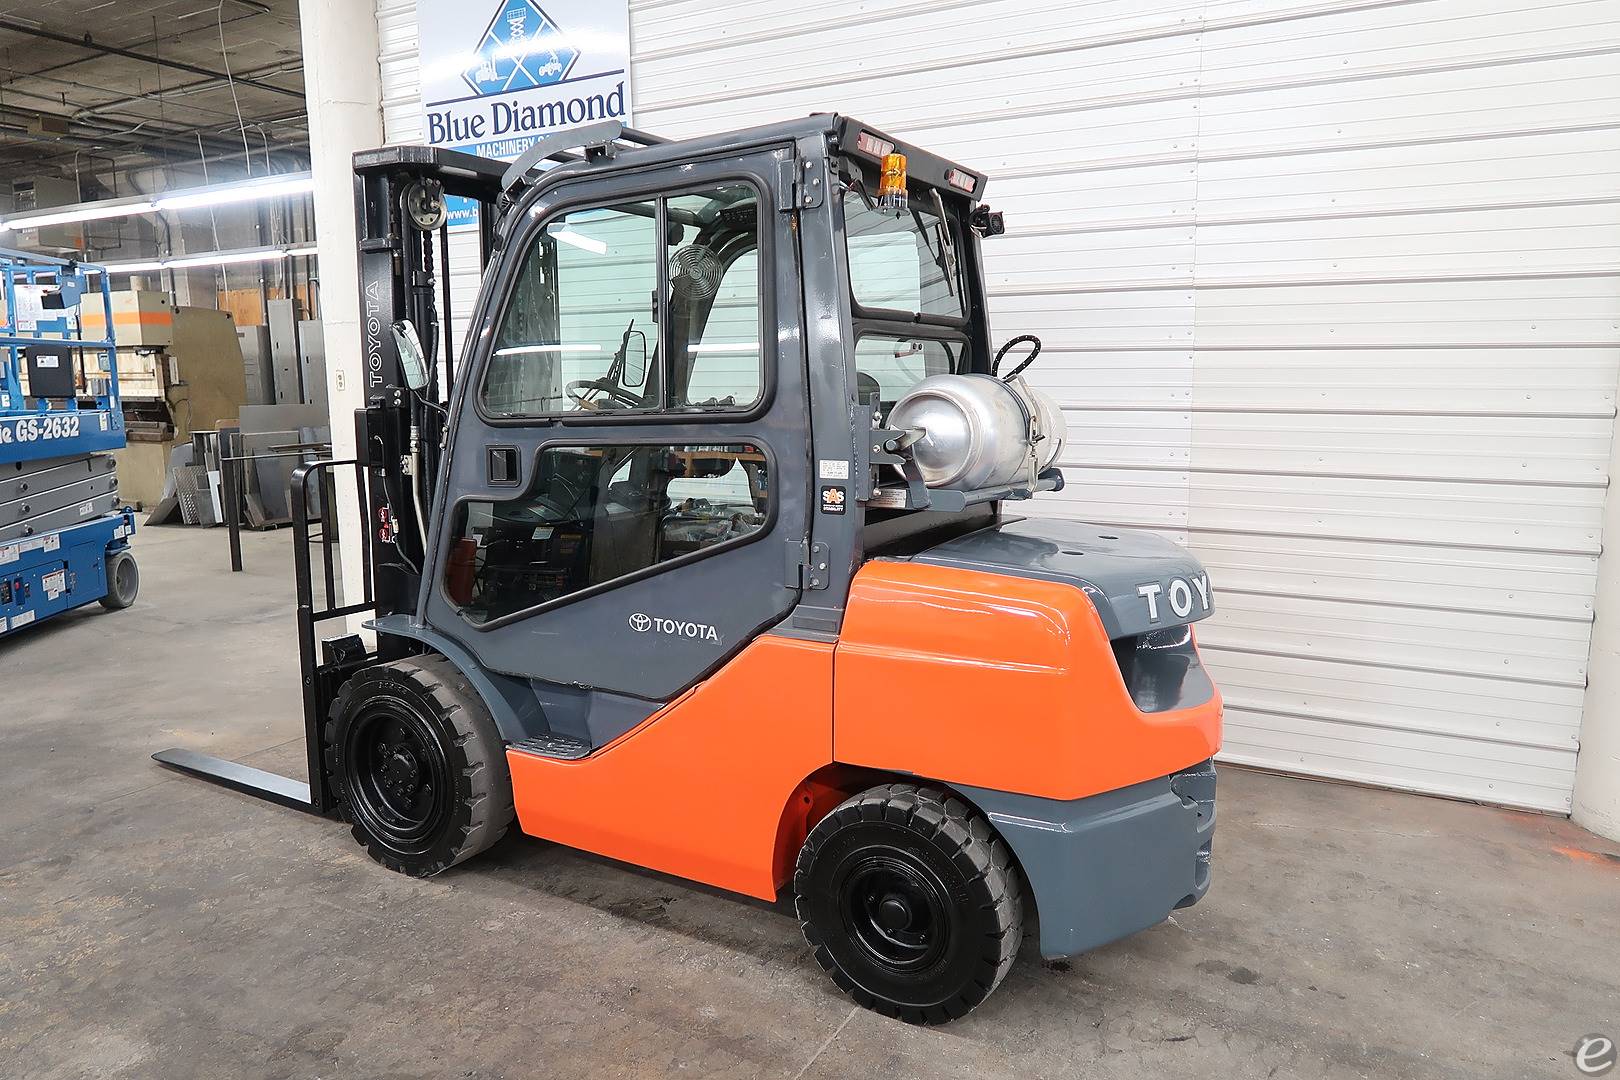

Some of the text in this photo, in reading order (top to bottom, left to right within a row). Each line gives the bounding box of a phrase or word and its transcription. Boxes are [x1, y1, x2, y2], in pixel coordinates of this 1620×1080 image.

[427, 81, 626, 144] Blue Diamond
[476, 137, 535, 158] MACHINERY
[366, 280, 383, 388] TOYOTA
[15, 416, 80, 442] GS-2632
[822, 488, 845, 504] SAS
[1137, 574, 1210, 620] TOY
[653, 617, 719, 641] TOYOTA
